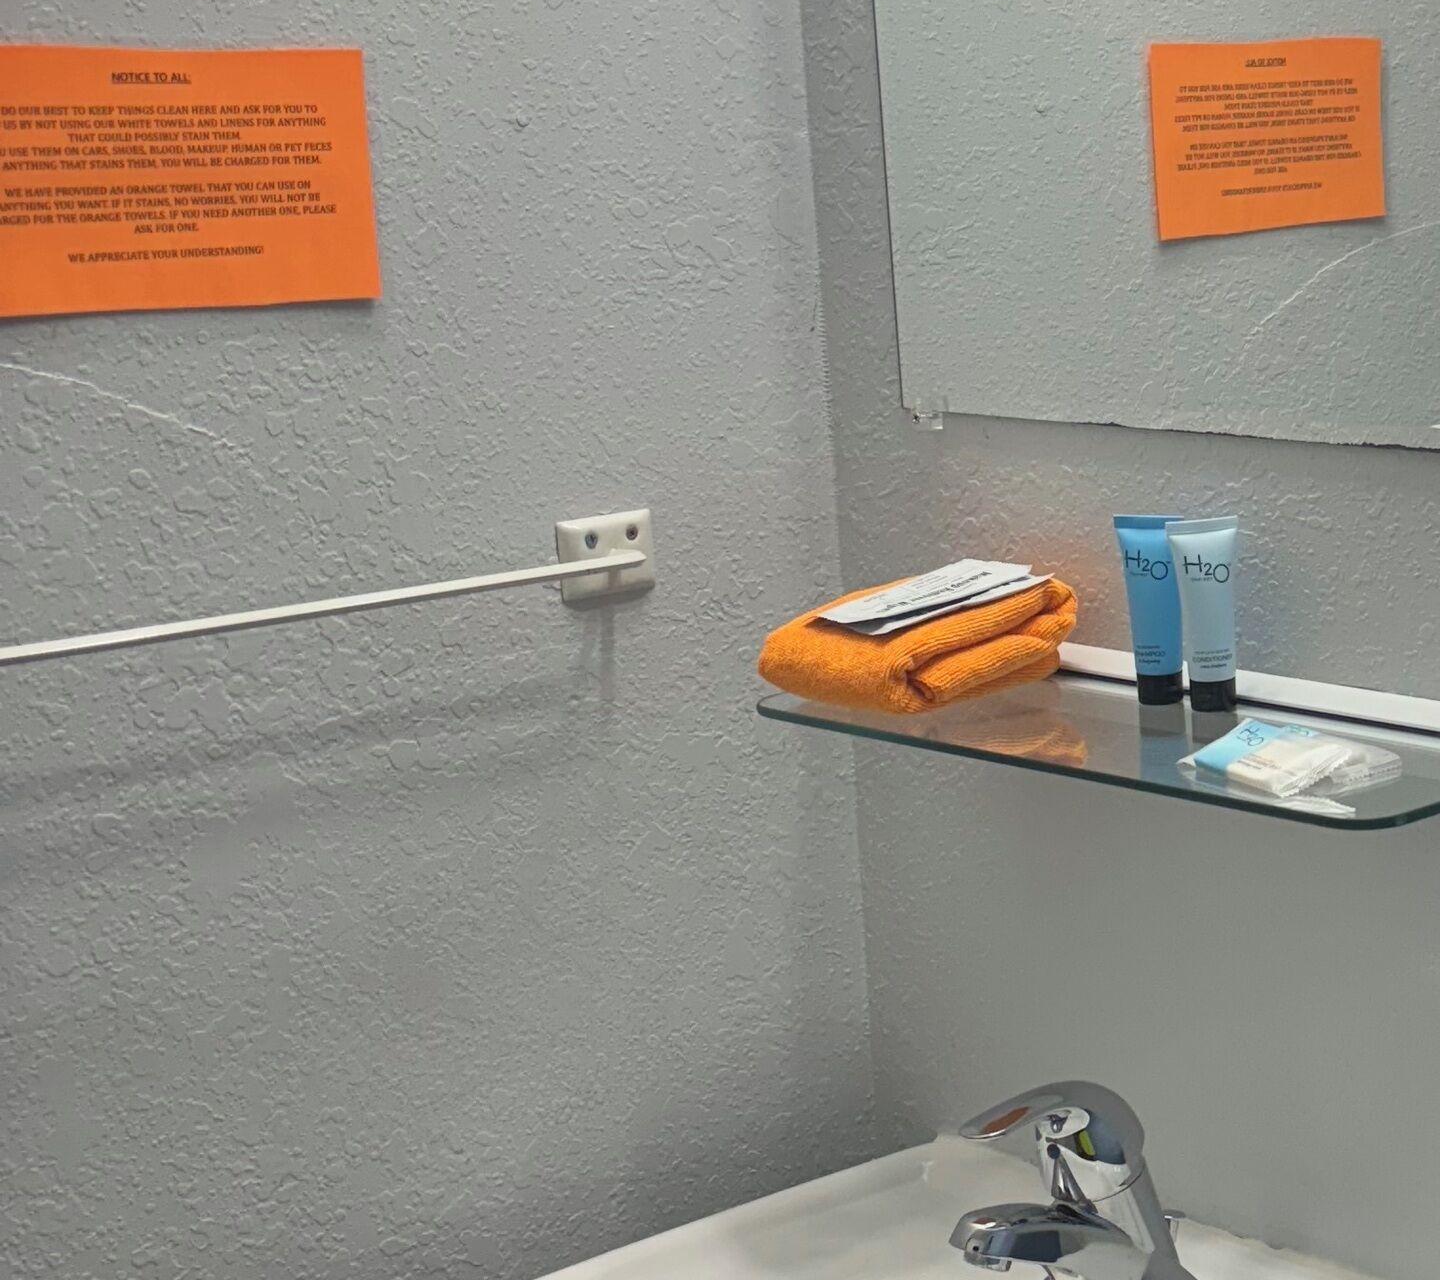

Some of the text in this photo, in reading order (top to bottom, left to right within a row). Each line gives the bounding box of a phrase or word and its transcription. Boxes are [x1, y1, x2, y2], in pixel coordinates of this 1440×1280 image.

[112, 72, 149, 83] NOTICE
[154, 72, 167, 83] TO
[1, 107, 15, 115] DO
[71, 107, 85, 115] TO
[89, 106, 113, 115] KEEP
[118, 106, 154, 115] THINGS
[157, 106, 188, 114] CLEAN
[191, 106, 216, 114] HERE
[220, 106, 240, 114] AND
[243, 105, 260, 113] ASK
[263, 105, 281, 113] FOR
[283, 105, 302, 113] YOU
[305, 105, 317, 113] TO
[4, 120, 17, 129] US
[20, 120, 31, 129] BY
[35, 120, 57, 128] NOT
[60, 120, 91, 129] USING
[118, 120, 151, 128] WHITE
[154, 119, 195, 128] TOWELS
[198, 119, 217, 127] AND
[221, 119, 254, 127] LINENS
[257, 118, 275, 127] FOR
[278, 118, 326, 127] ANYTHING
[68, 133, 94, 142] THAT
[98, 133, 131, 141] COULD
[135, 132, 180, 141] POSSIBLY
[183, 132, 209, 140] STAIN
[9, 147, 28, 156] USE
[32, 147, 61, 156] THEM
[65, 147, 78, 155] ON
[231, 144, 266, 152] HUMAN
[269, 144, 282, 152] OR
[285, 143, 302, 151] PET
[305, 142, 332, 151] FECES
[3, 161, 57, 170] ANYTHING
[59, 160, 86, 169] THAT
[90, 160, 124, 168] STAINS
[161, 159, 181, 167] YOU
[183, 158, 208, 167] WILL
[211, 158, 222, 166] BE
[225, 157, 268, 166] CHARGED
[272, 156, 290, 165] FOR
[5, 188, 22, 197] WE
[25, 187, 51, 197] HAVE
[55, 187, 107, 196] PROVIDED
[110, 186, 124, 195] AN
[127, 185, 167, 194] ORANGE
[208, 183, 232, 192] THAT
[235, 182, 253, 191] YOU
[256, 182, 275, 190] CAN
[278, 181, 295, 190] USE
[297, 180, 310, 189] ON
[54, 201, 74, 210] YOU
[112, 200, 120, 208] IF
[123, 199, 132, 208] IT
[175, 197, 188, 206] NO
[240, 194, 258, 204] YOU
[261, 194, 284, 203] WILL
[287, 193, 306, 202] NOT
[309, 193, 320, 201] BE
[33, 215, 54, 224] FOR
[57, 214, 77, 223] THE
[79, 213, 121, 222] ORANGE
[170, 210, 177, 219] IF
[181, 210, 200, 218] YOU
[203, 209, 228, 218] NEED
[231, 207, 276, 217] ANOTHER
[303, 205, 337, 214] PLEASE
[134, 225, 152, 234] ASK
[156, 224, 175, 233] FOR
[68, 253, 85, 263] WE
[88, 250, 149, 262] APPRECIATE
[152, 250, 178, 259] YOUR
